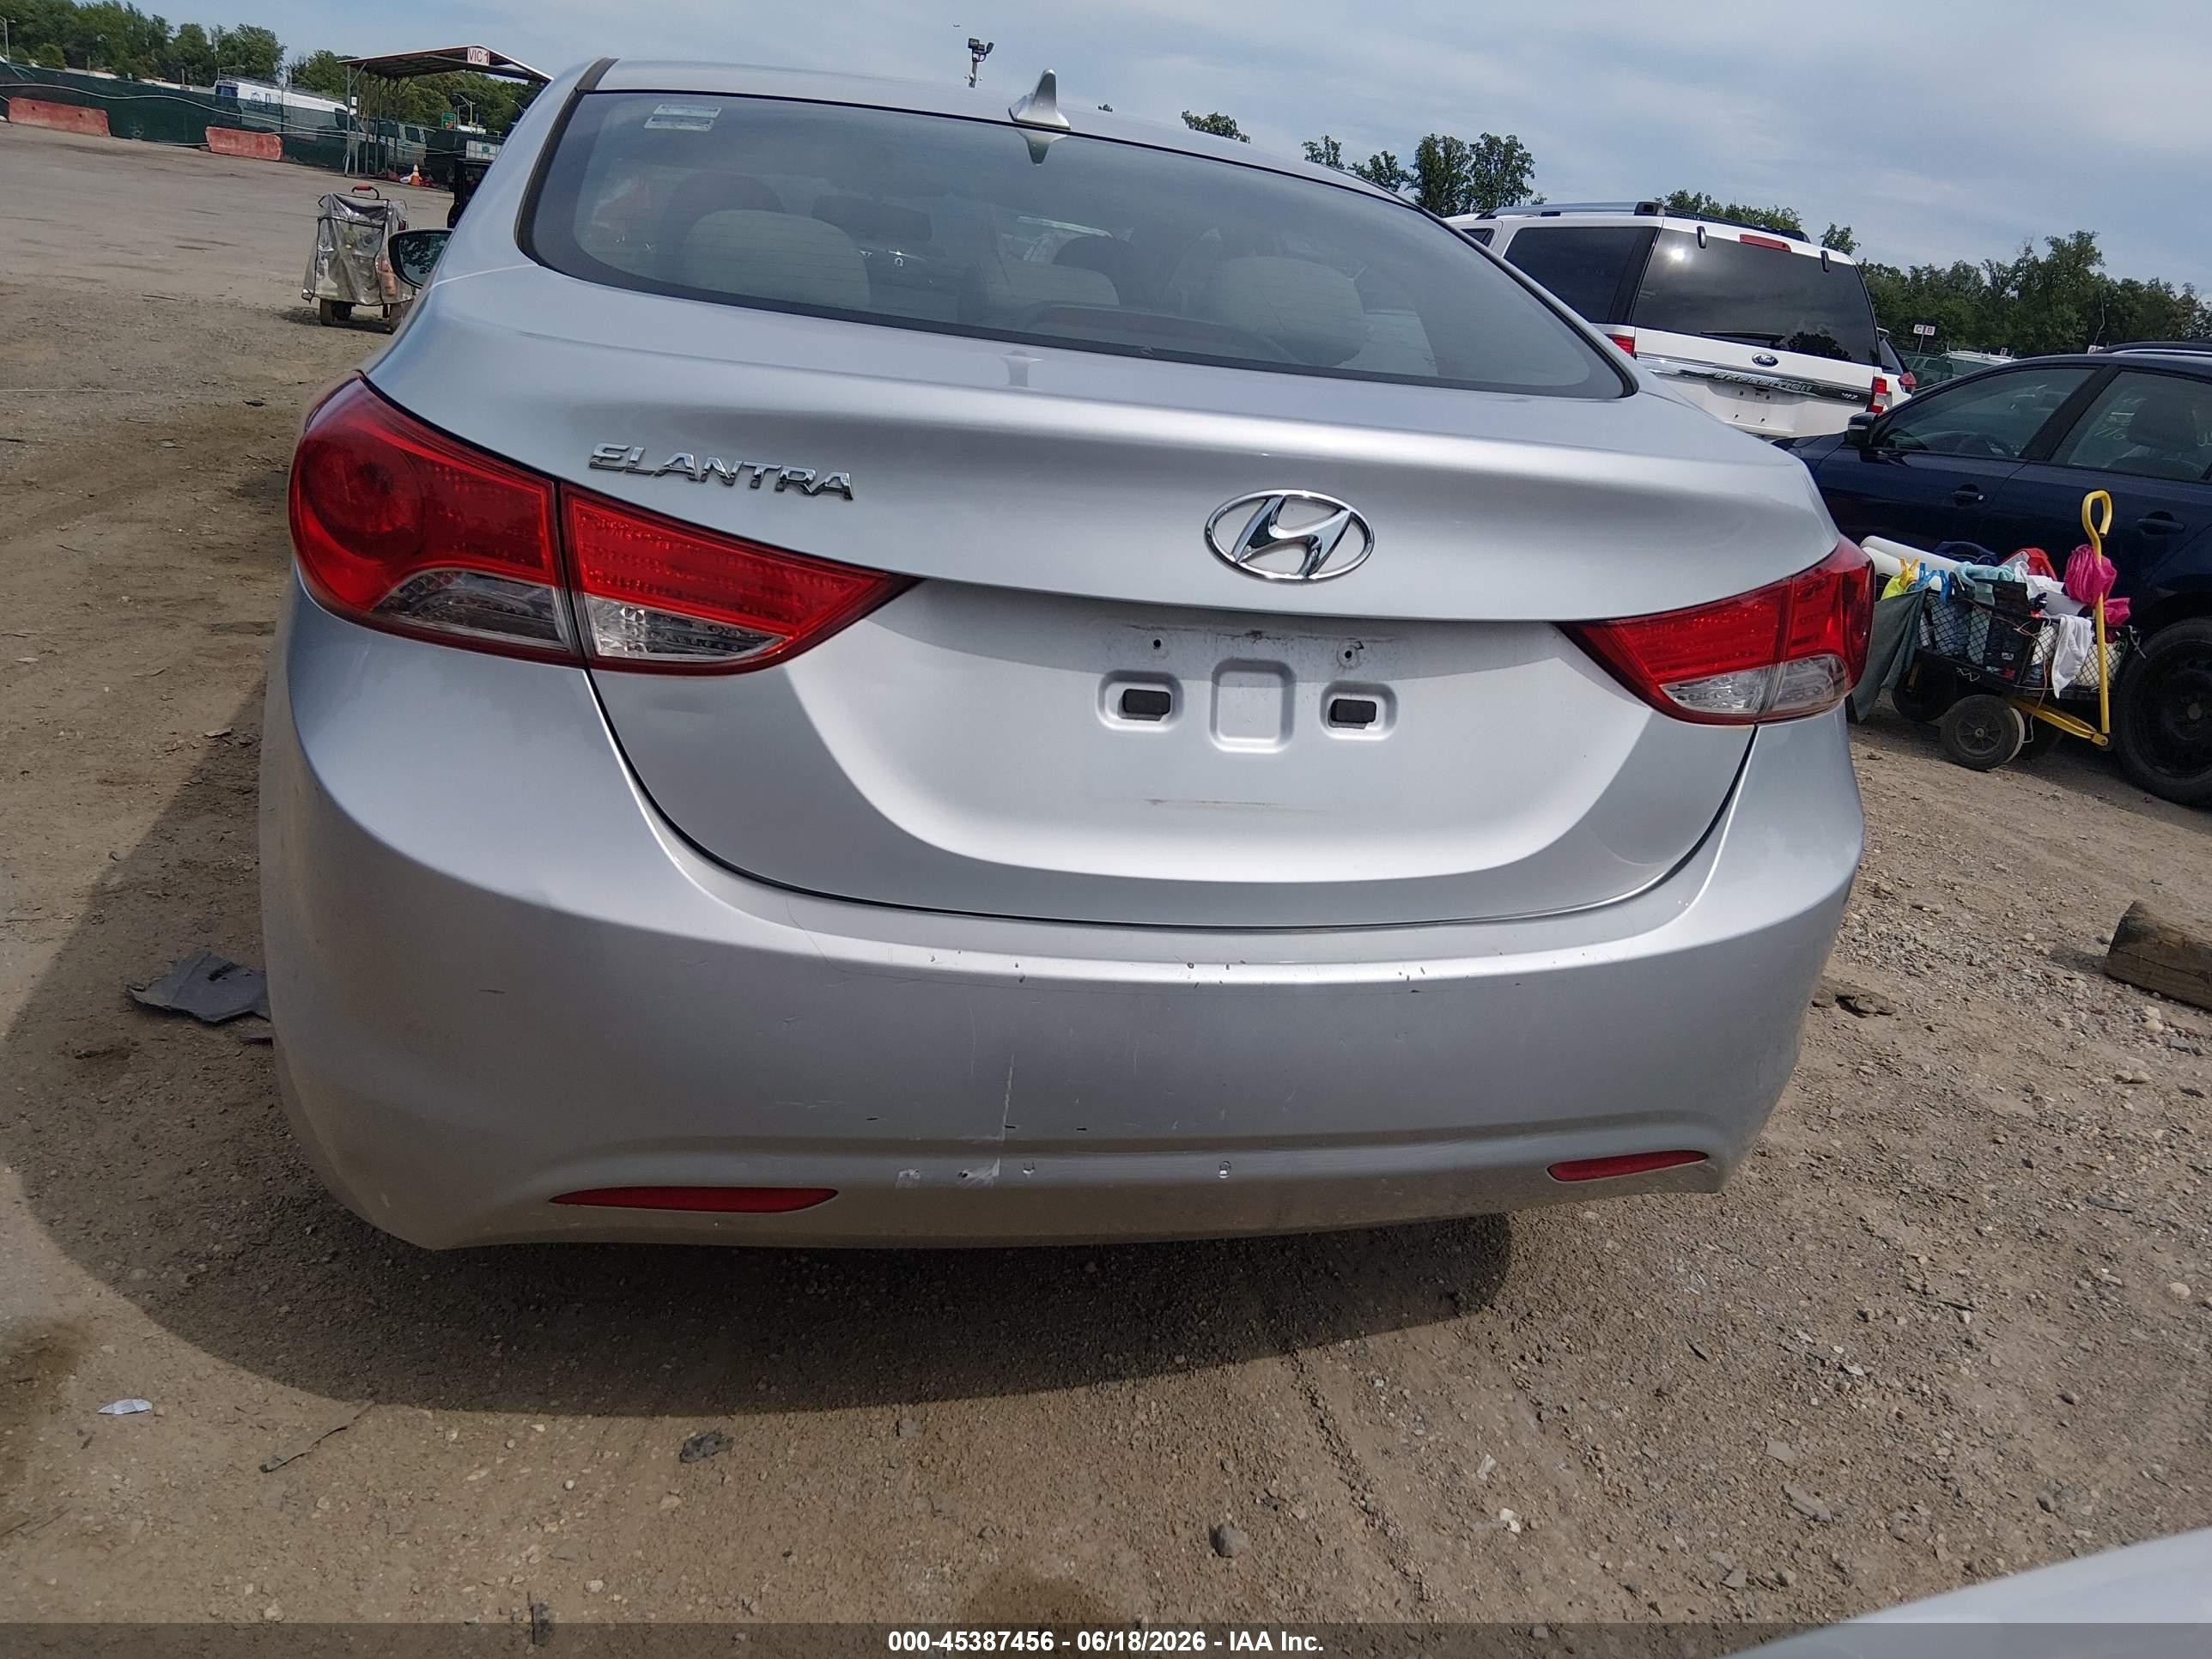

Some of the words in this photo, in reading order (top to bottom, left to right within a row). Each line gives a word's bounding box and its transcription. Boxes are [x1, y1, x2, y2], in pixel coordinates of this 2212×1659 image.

[468, 49, 483, 62] VIC
[484, 52, 489, 64] 1
[589, 442, 854, 501] ELANTRA
